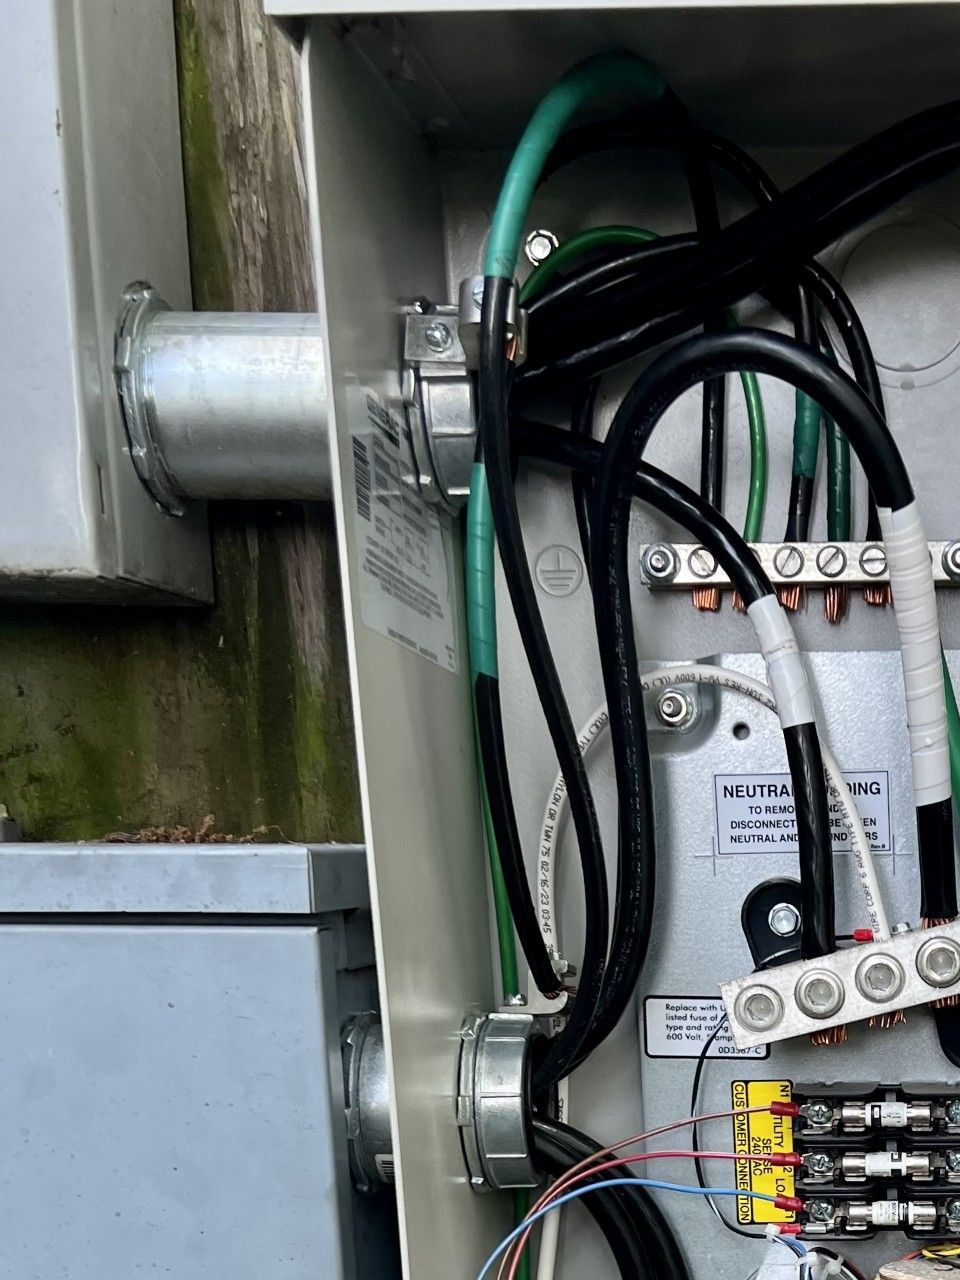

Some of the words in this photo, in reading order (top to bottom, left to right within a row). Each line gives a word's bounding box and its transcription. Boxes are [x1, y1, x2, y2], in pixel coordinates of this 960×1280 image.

[749, 805, 762, 814] TO
[765, 805, 795, 814] REMO
[730, 819, 796, 829] DISCONNECT
[730, 834, 776, 843] NEUTRAL
[666, 1004, 697, 1012] Replace
[780, 1084, 790, 1098] N1
[773, 1116, 784, 1148] TILITY
